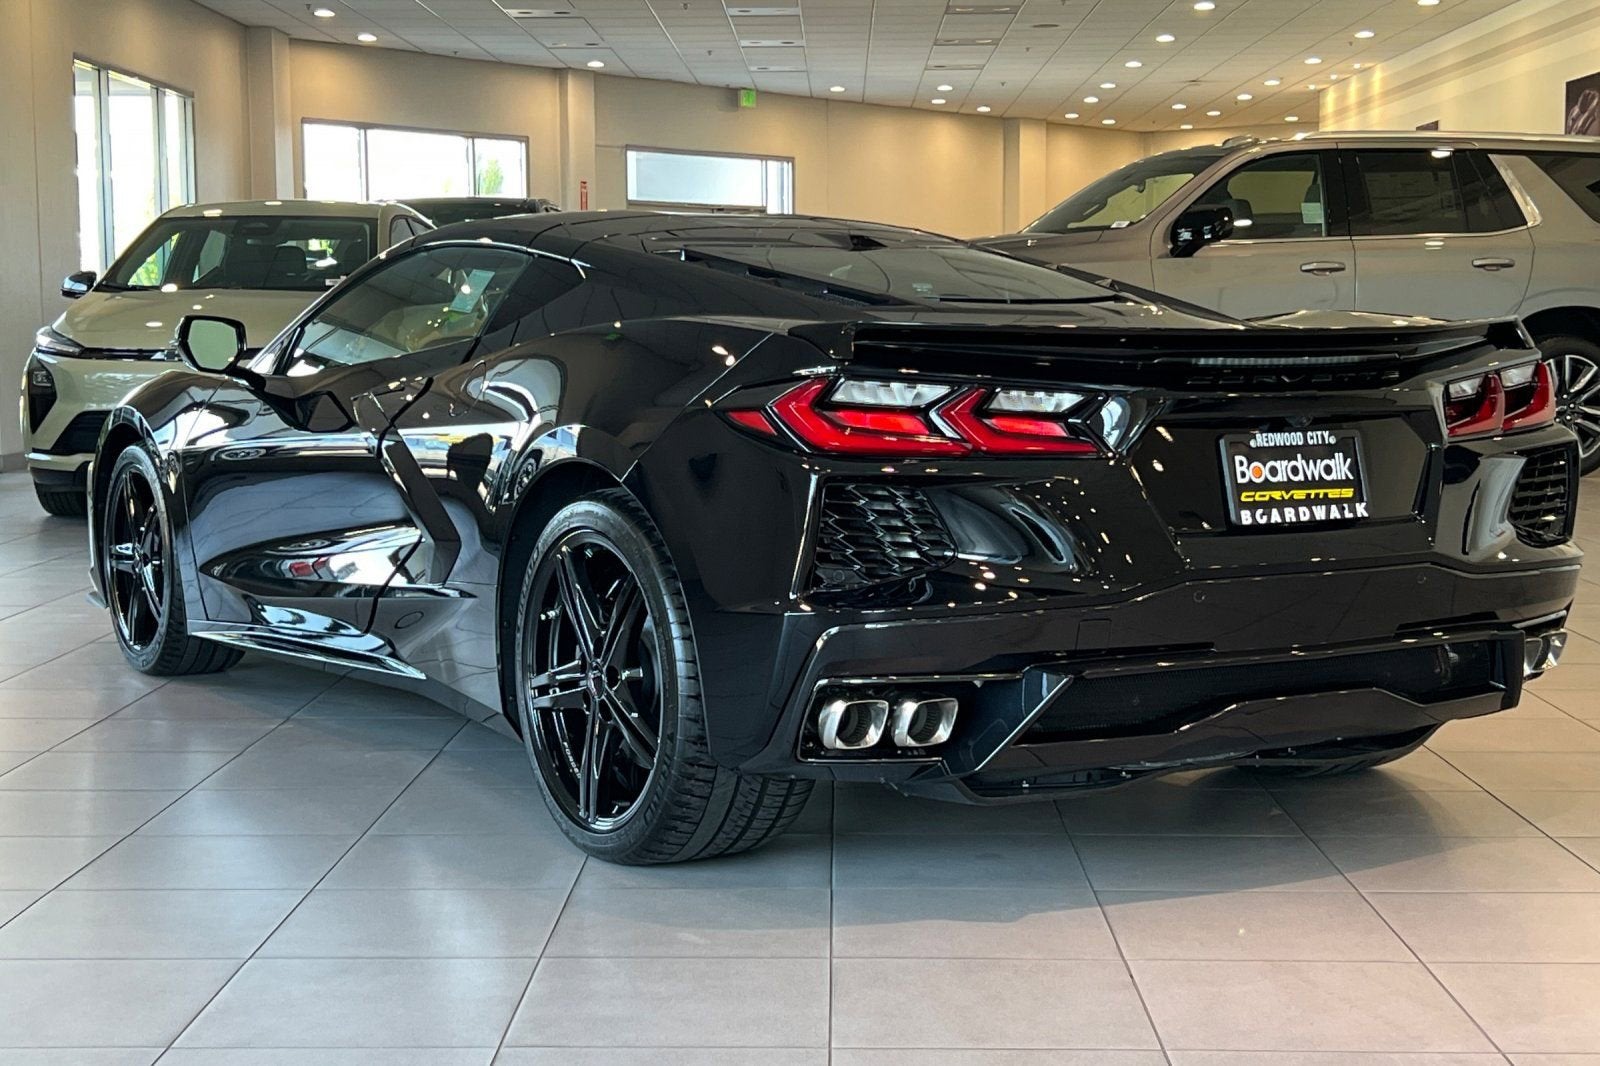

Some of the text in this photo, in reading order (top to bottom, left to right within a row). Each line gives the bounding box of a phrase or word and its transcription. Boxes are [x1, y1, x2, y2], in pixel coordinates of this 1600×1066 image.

[1255, 430, 1330, 447] REDWOOD CITY
[1234, 452, 1354, 484] Boardwalk
[1240, 488, 1354, 502] CORVETTES
[1240, 502, 1369, 525] BOARDWALK
